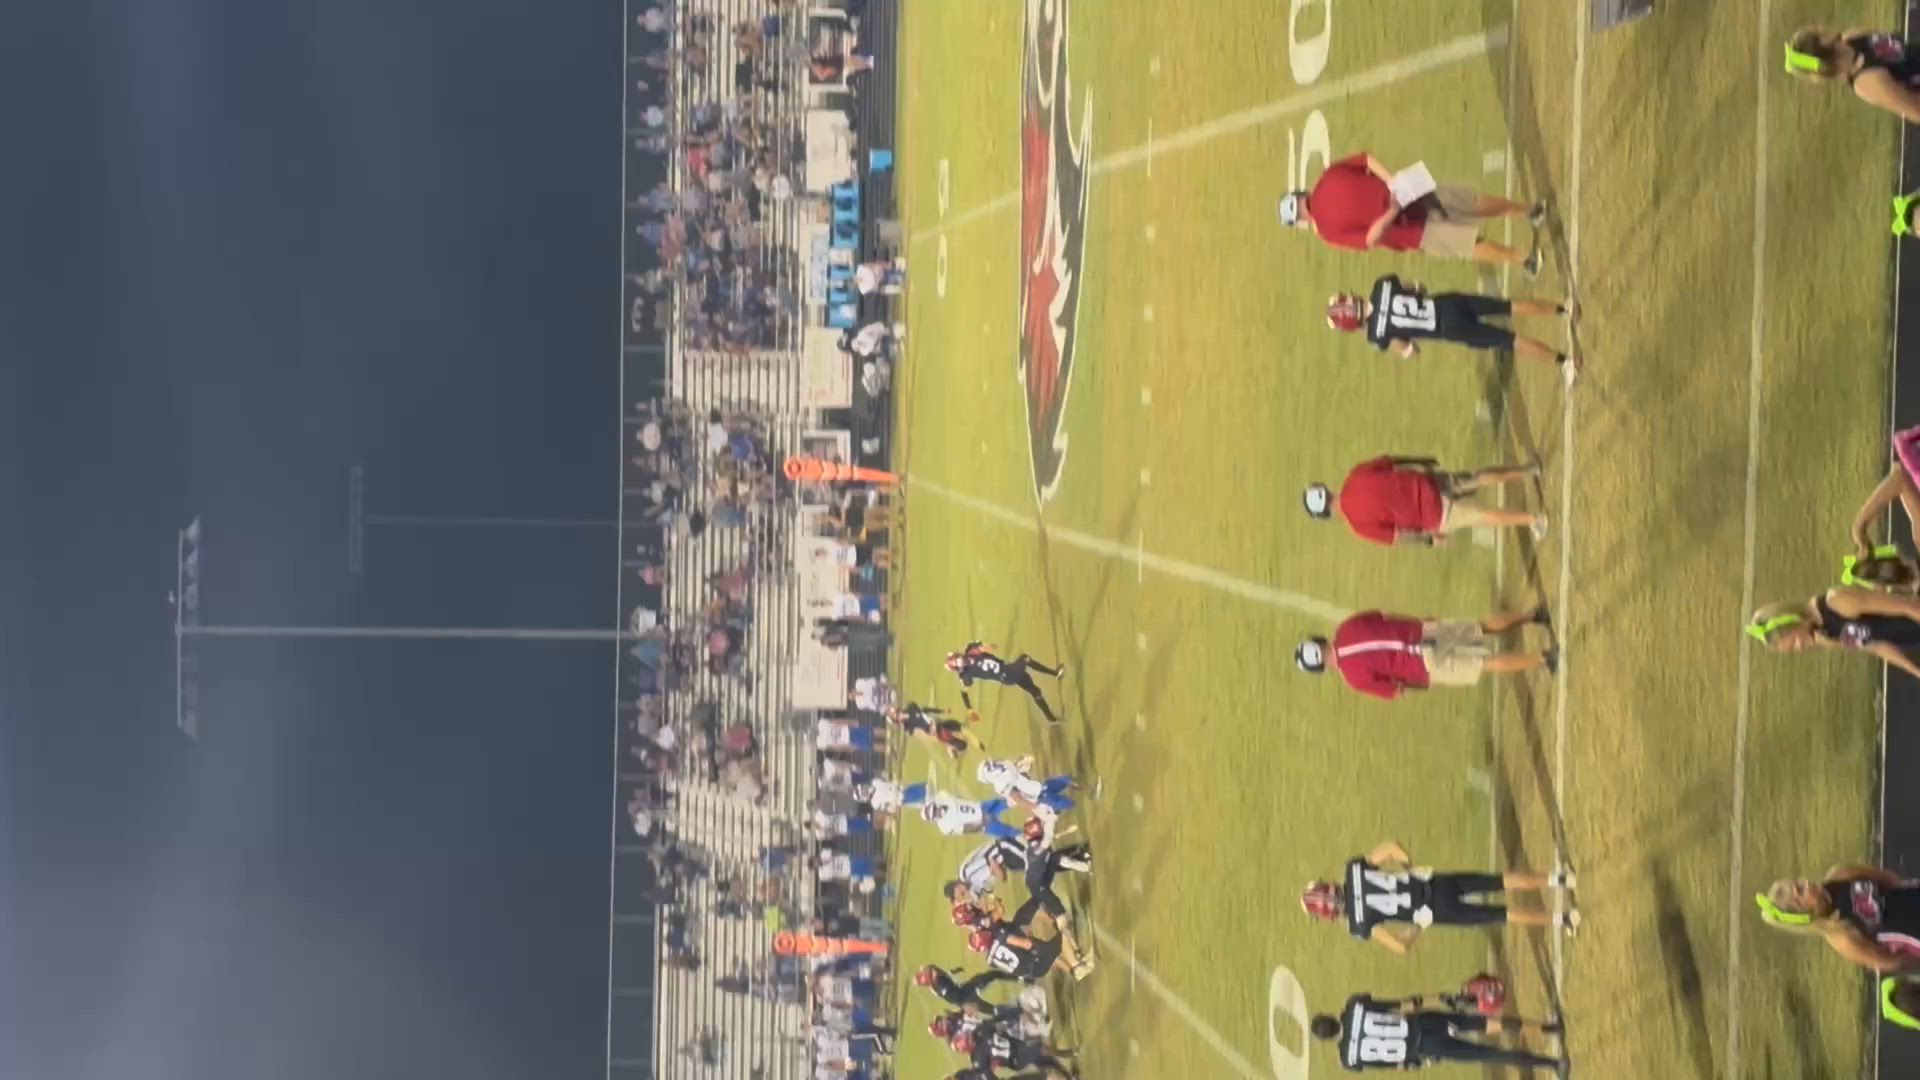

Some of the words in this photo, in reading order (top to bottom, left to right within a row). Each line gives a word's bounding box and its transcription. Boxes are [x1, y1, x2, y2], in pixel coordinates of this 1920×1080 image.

[1391, 294, 1436, 332] 12
[981, 659, 1000, 674] 3
[1365, 869, 1411, 916] 44
[991, 945, 1019, 973] 13
[1360, 1012, 1408, 1062] 80
